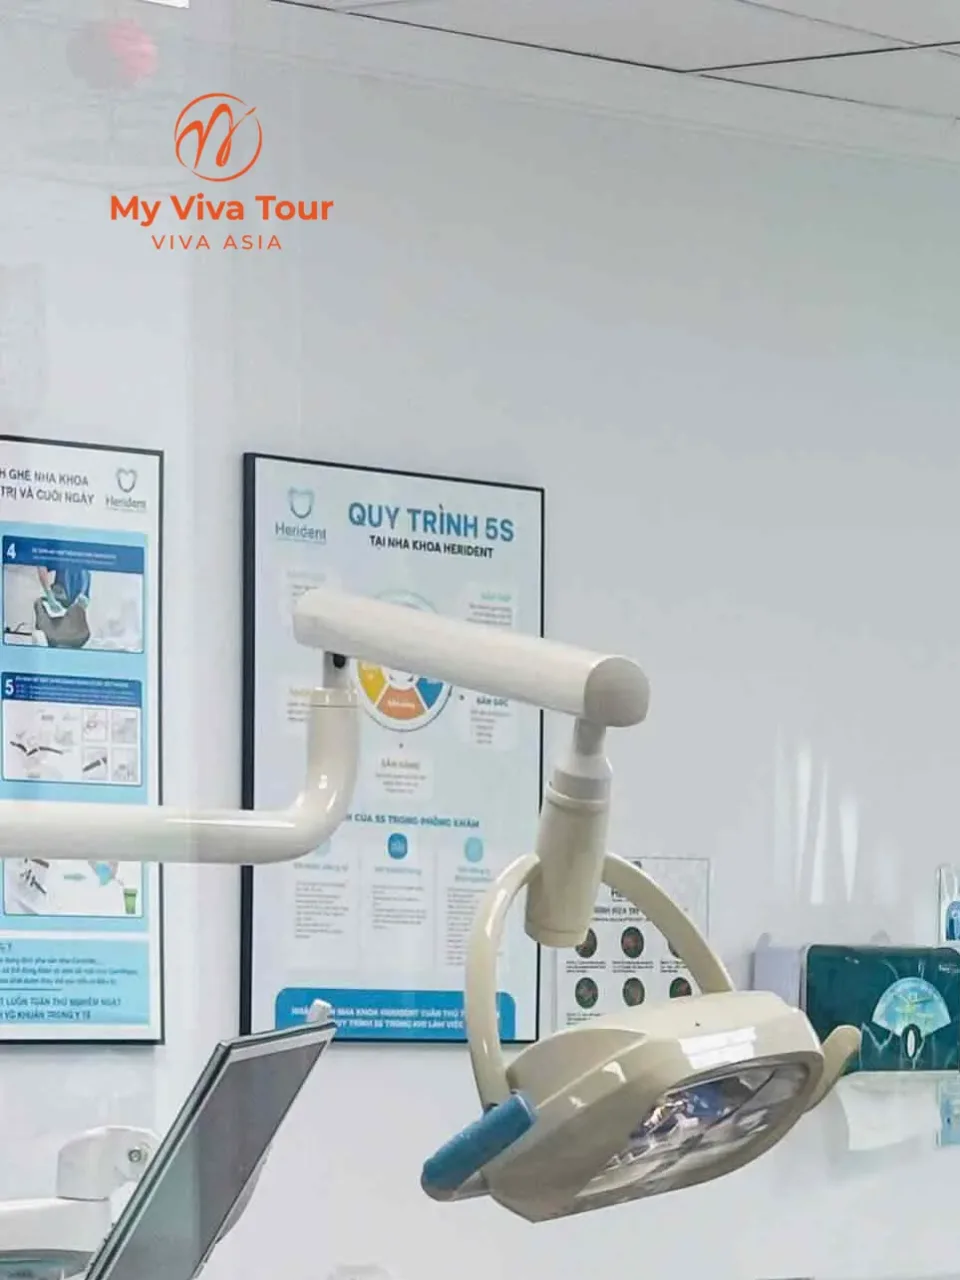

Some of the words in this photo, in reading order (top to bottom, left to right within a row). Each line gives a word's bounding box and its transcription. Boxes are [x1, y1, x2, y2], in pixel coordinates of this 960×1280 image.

[58, 472, 89, 486] KHOA
[348, 502, 400, 530] QUY
[407, 503, 479, 539] TRÌNH
[484, 517, 515, 542] 5S
[275, 522, 327, 541] Herident
[6, 543, 16, 560] 4
[369, 534, 386, 549] TẠI
[387, 538, 410, 550] NHA
[412, 541, 442, 553] KHOA
[443, 544, 494, 559] HERIDENT
[5, 679, 14, 696] 5
